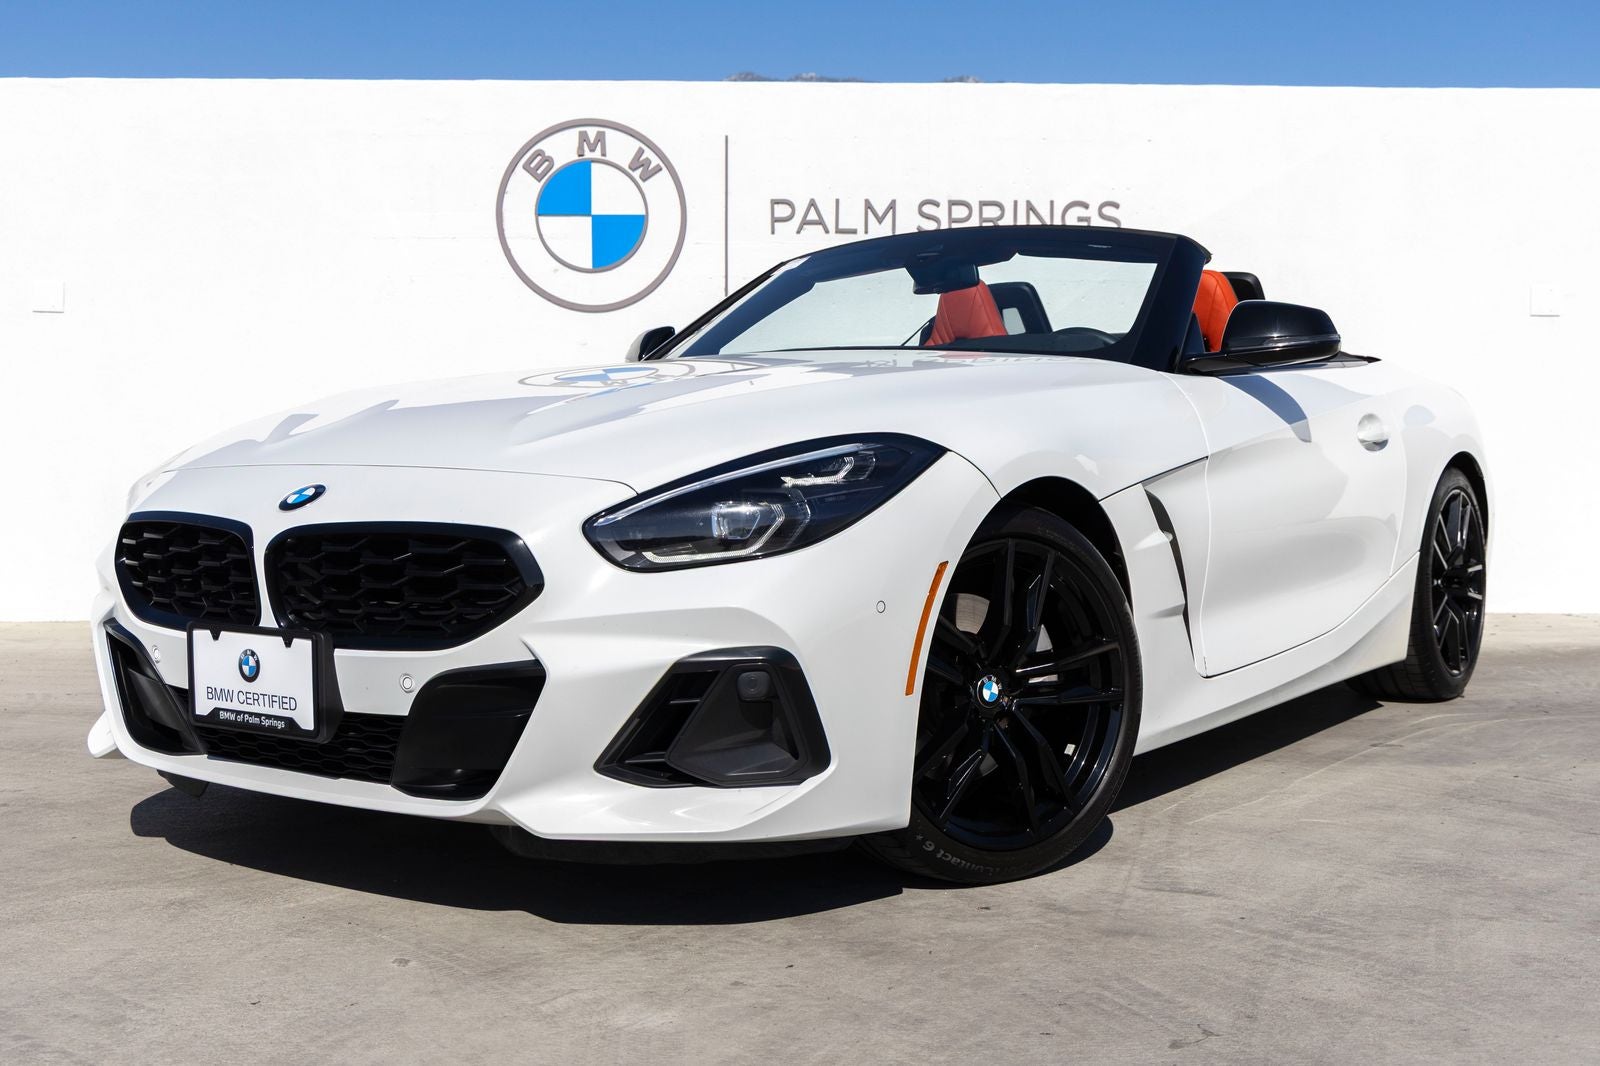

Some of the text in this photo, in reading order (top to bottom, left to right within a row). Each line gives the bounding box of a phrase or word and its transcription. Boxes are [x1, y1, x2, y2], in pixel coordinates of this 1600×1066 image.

[522, 130, 663, 183] BMW
[770, 198, 1122, 235] PALM SPRINGS
[206, 686, 298, 711] BMW CERTIFIED
[219, 711, 285, 729] BMW of Palm Springs
